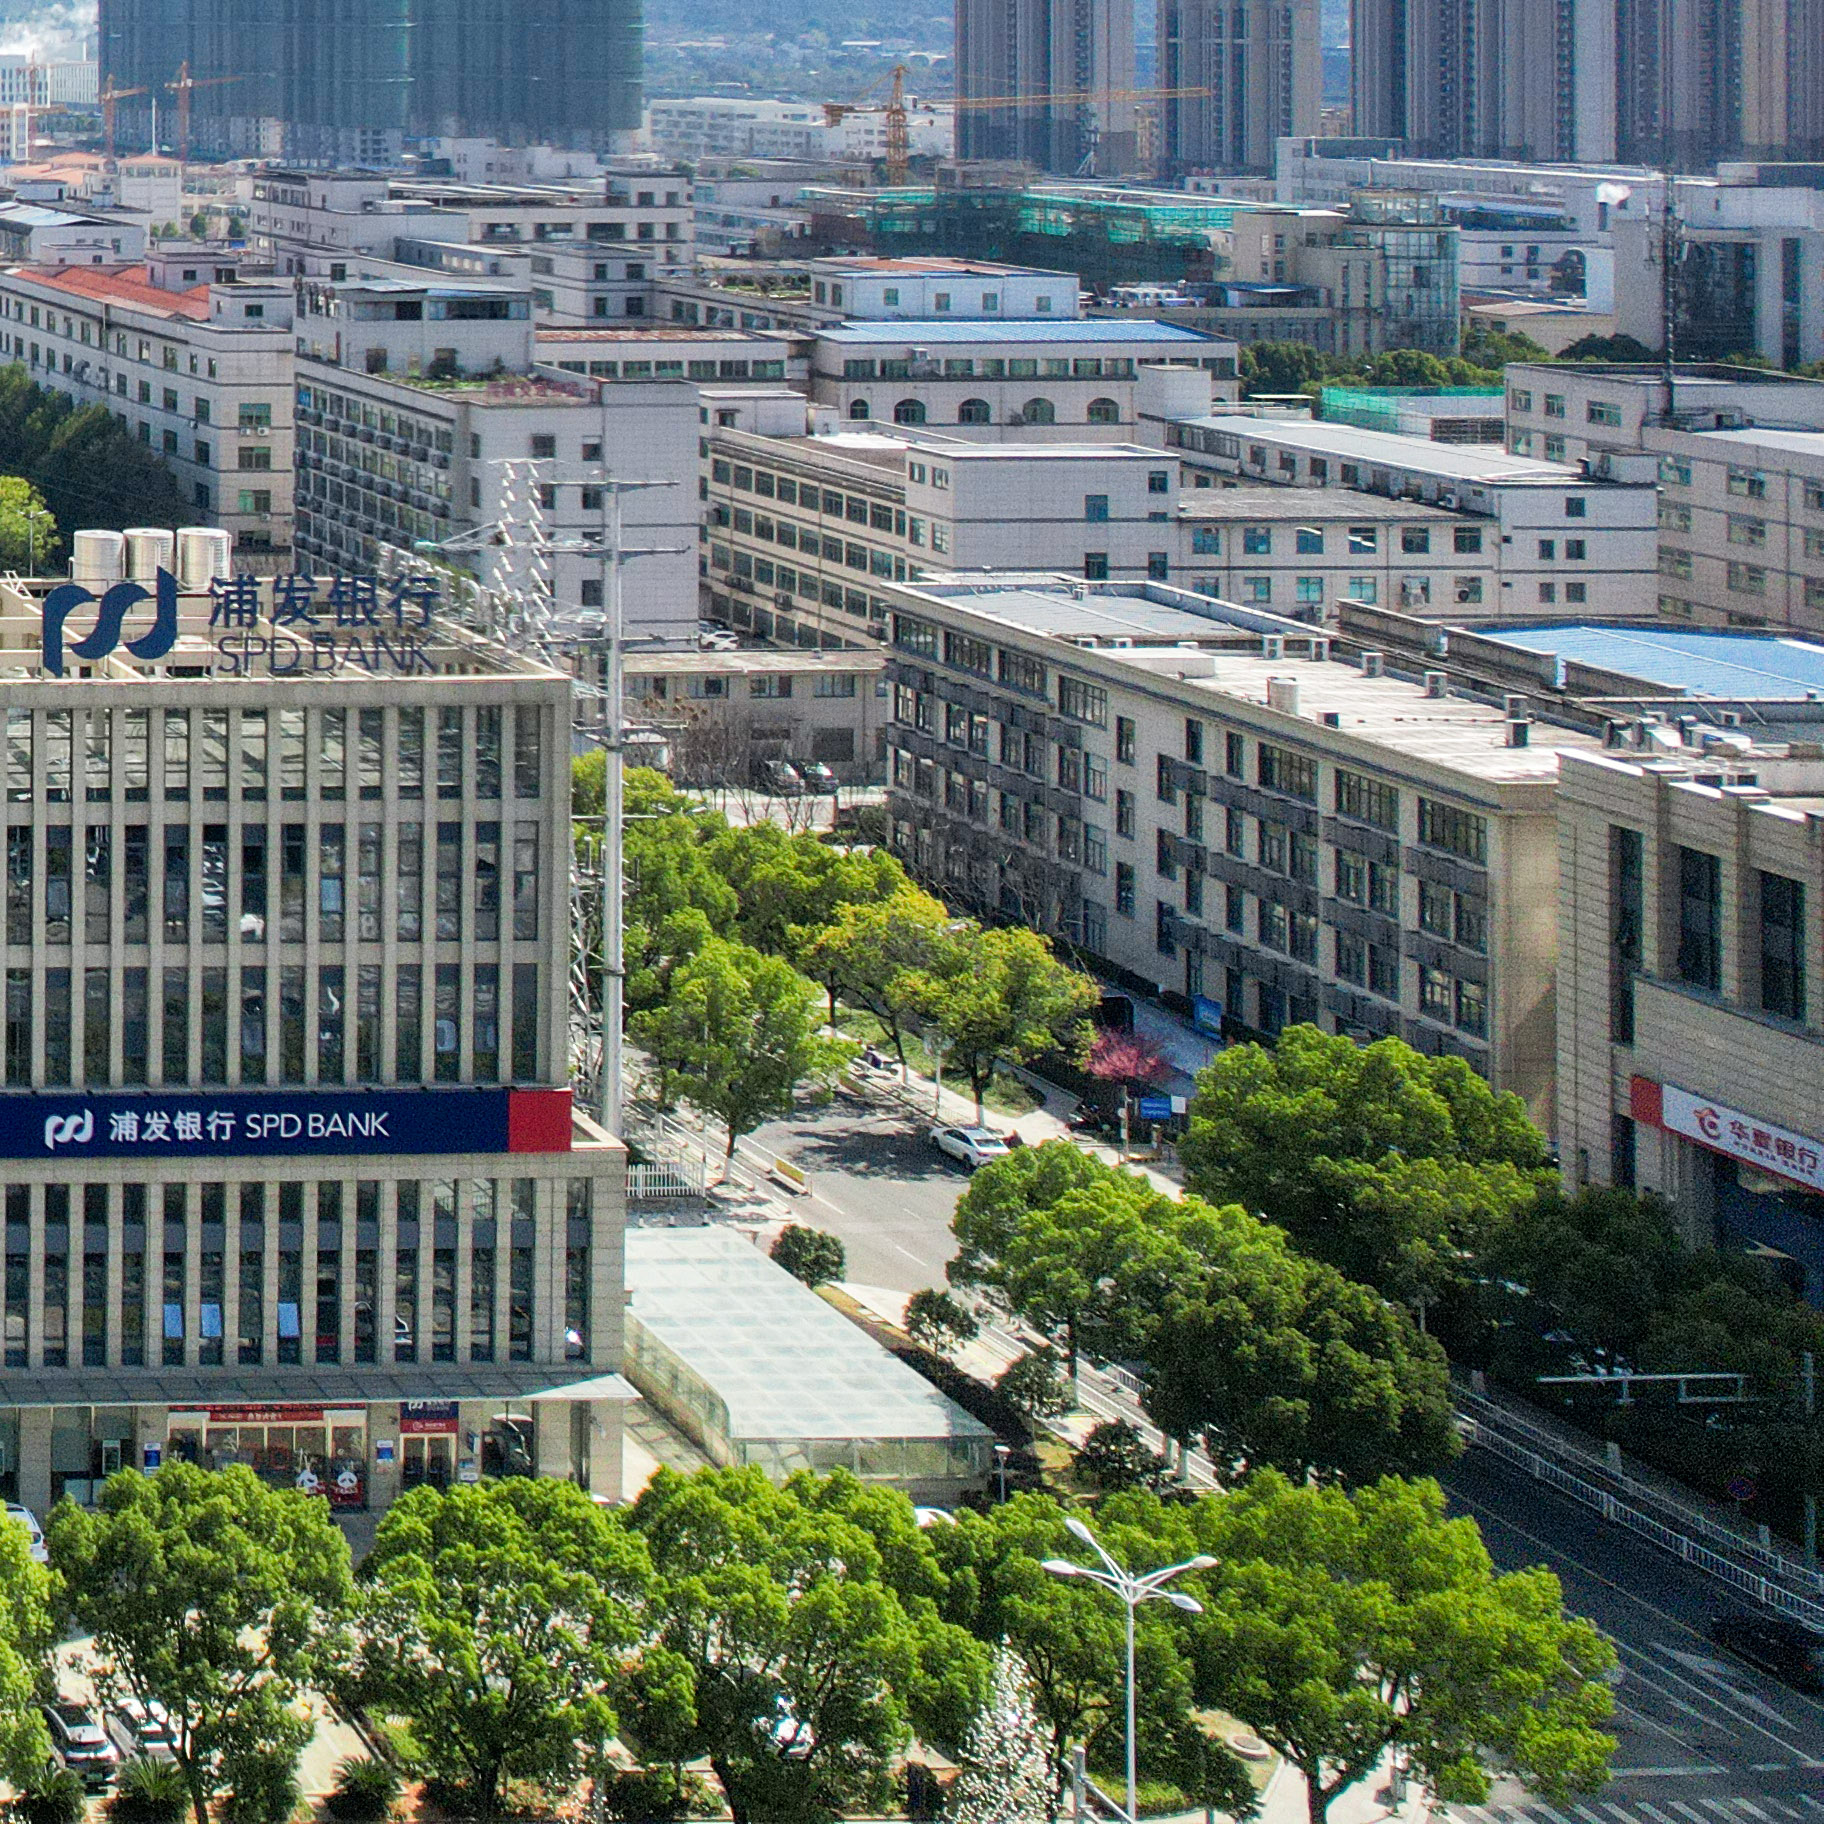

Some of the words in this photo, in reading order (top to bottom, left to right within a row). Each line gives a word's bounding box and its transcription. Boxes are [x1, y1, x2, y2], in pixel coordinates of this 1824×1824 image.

[208, 572, 442, 628] 浦发银行
[217, 636, 302, 673] SPD
[314, 635, 440, 673] BANK
[109, 1110, 237, 1144] 浦发银行
[245, 1112, 302, 1139] SPD
[308, 1111, 390, 1139] BANK
